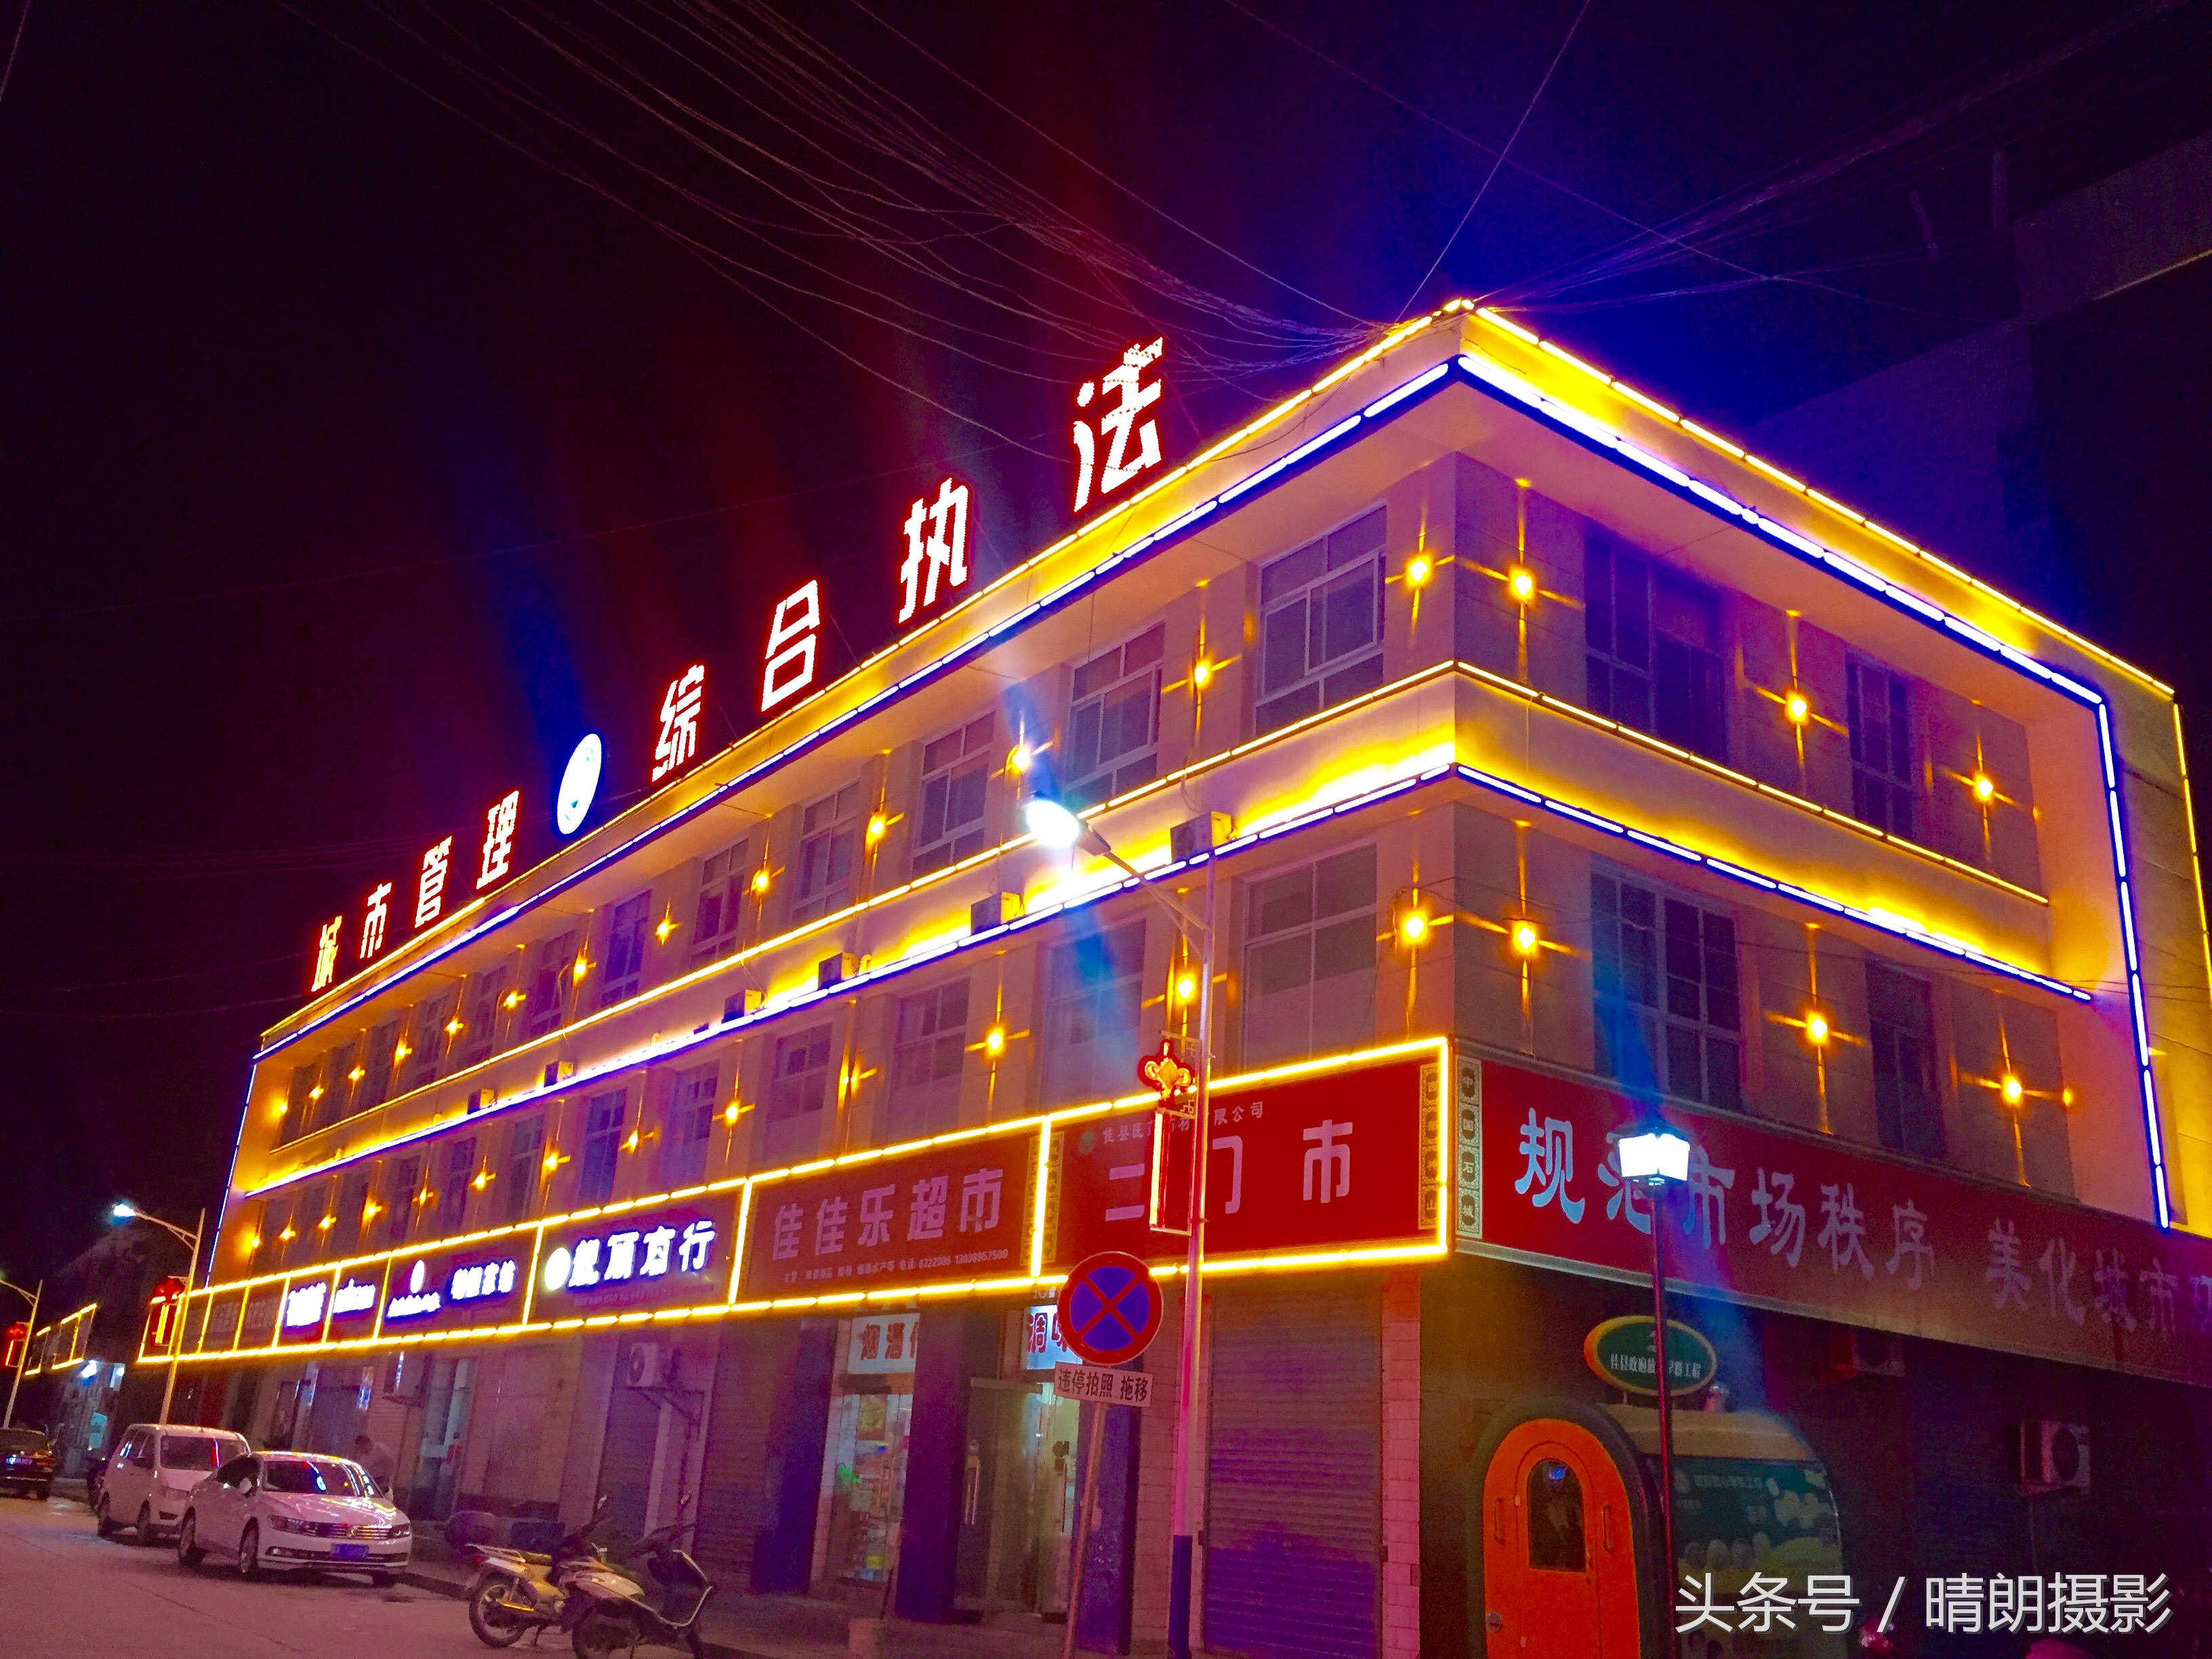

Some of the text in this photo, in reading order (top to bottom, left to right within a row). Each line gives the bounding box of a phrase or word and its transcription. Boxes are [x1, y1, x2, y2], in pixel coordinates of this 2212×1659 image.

[652, 337, 1164, 781] 综合执法
[773, 1168, 1004, 1261] 佳佳乐超市
[857, 1321, 919, 1361] 烟酒
[1058, 1368, 1149, 1402] 违停拍照 拖移
